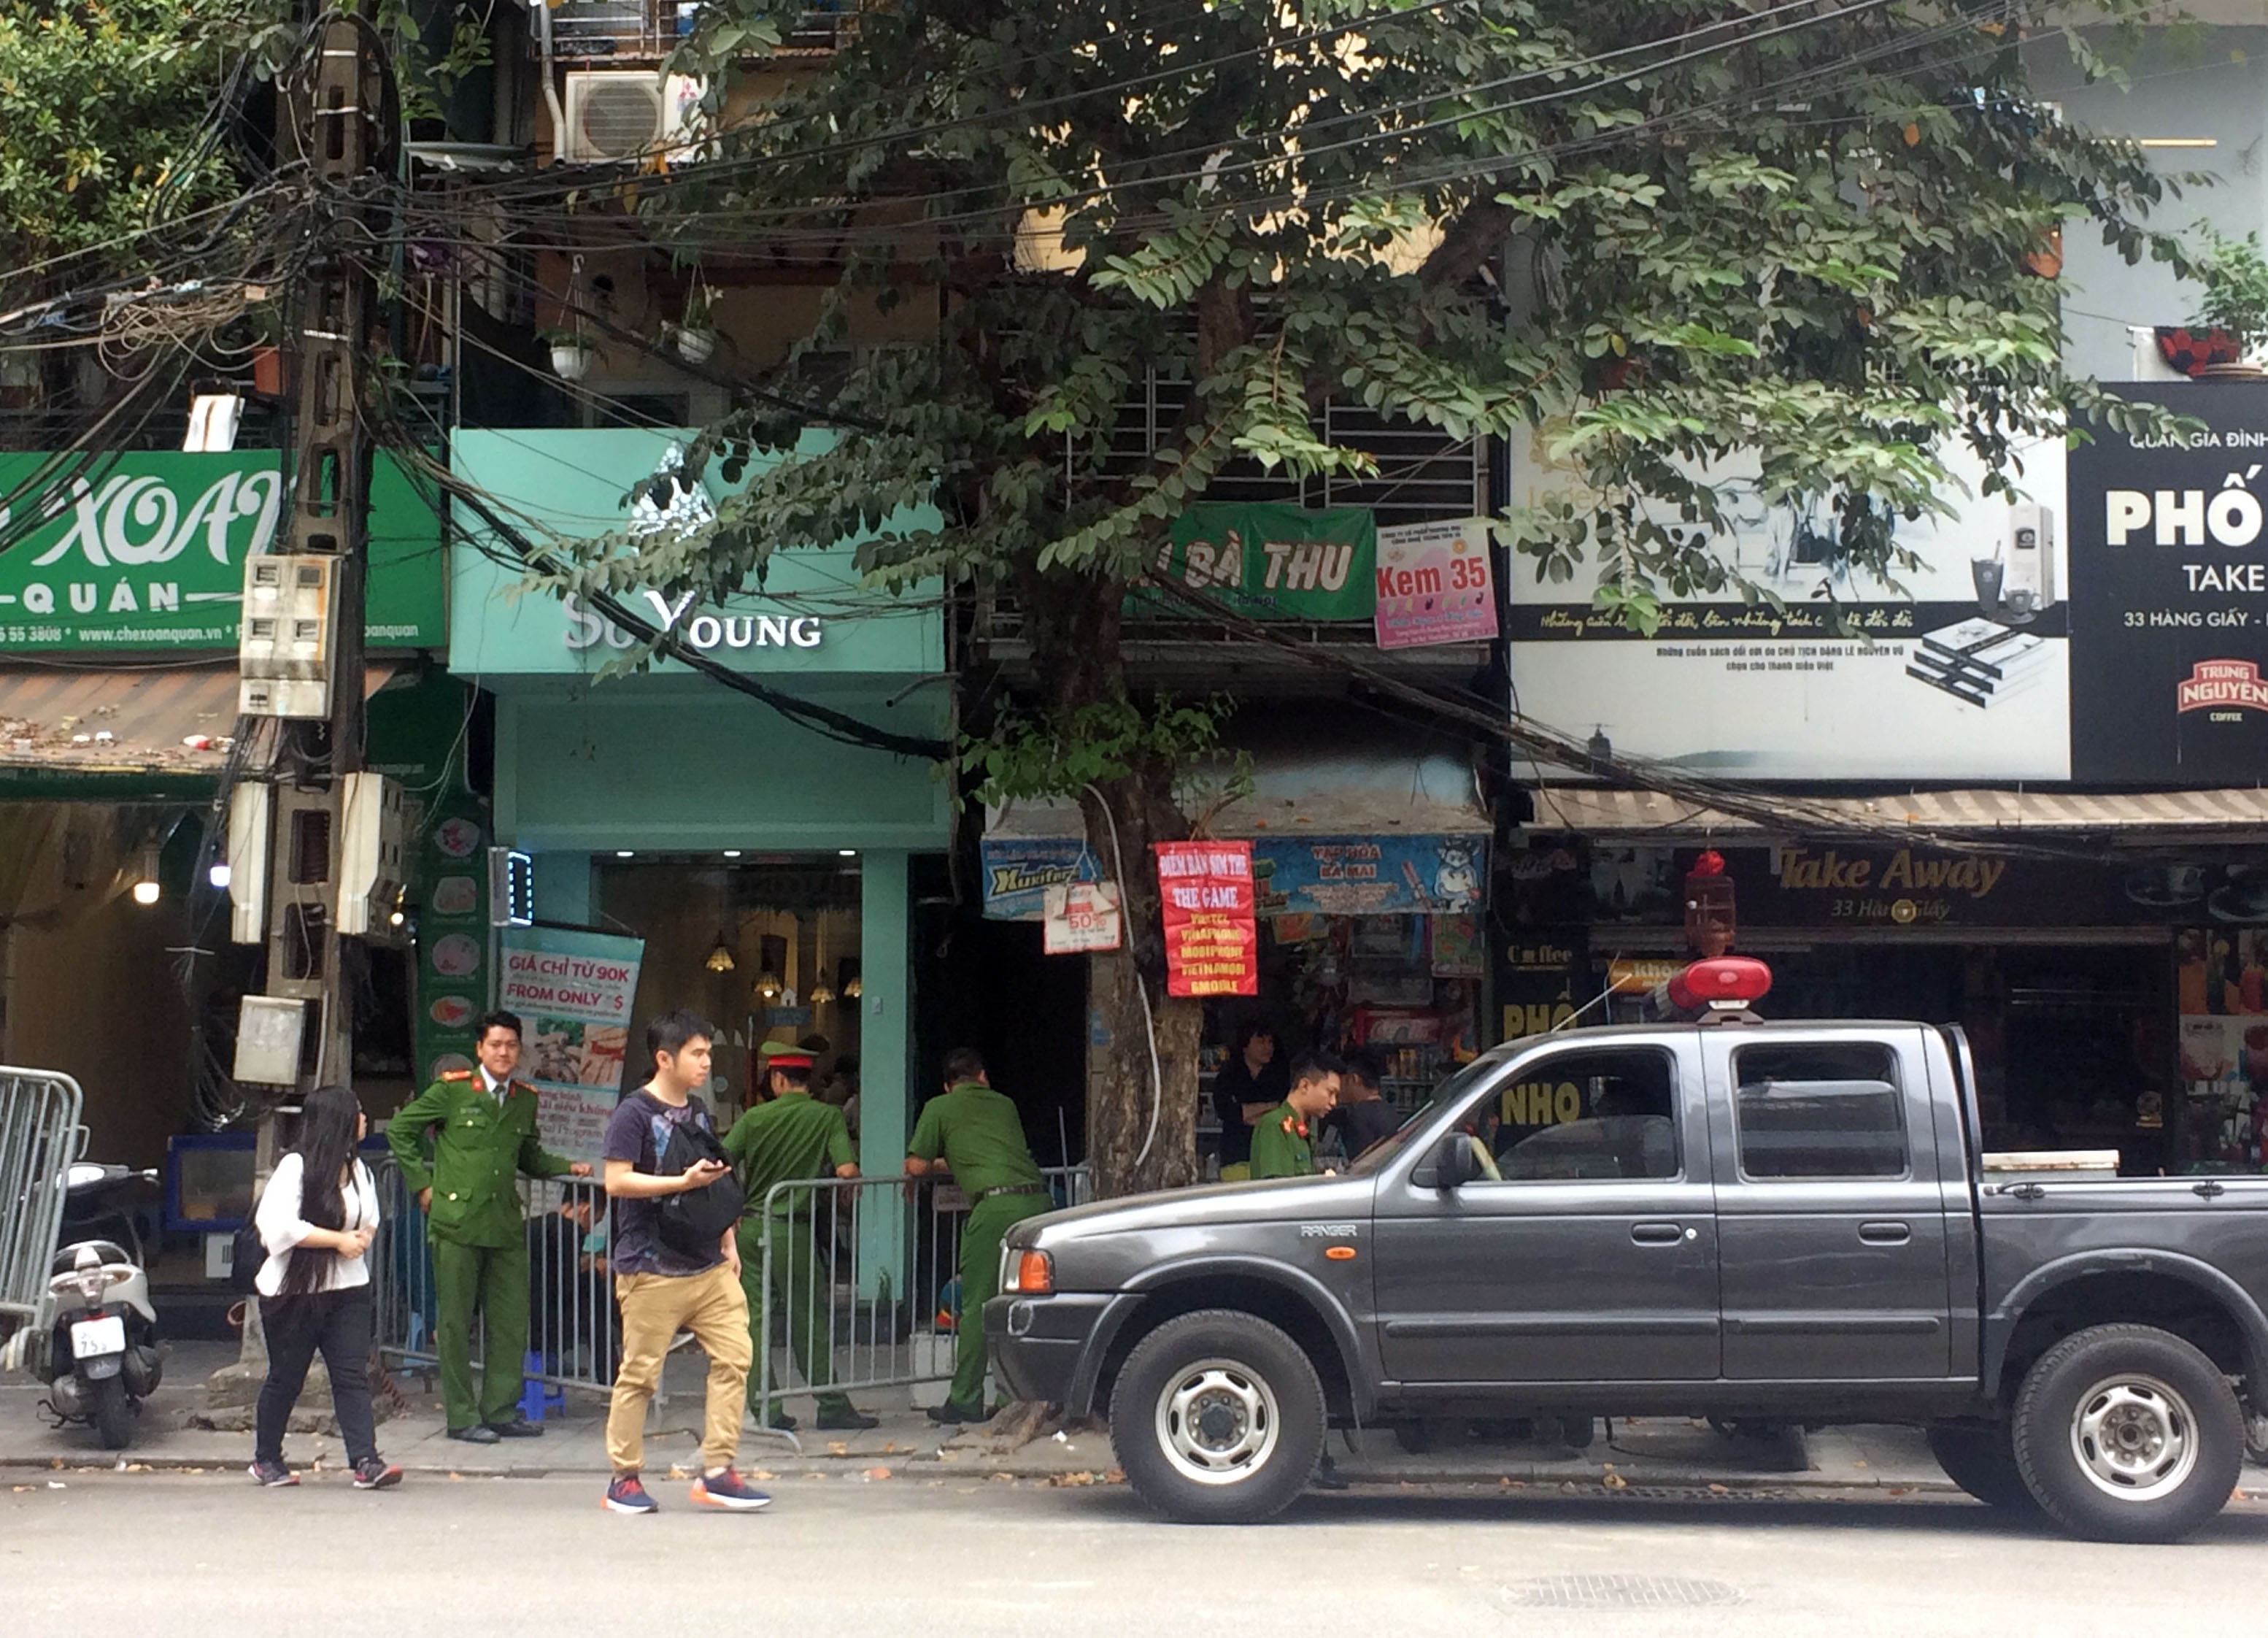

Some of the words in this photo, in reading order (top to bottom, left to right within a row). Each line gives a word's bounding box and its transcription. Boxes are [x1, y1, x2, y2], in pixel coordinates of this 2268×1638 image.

[2190, 432, 2221, 447] GIA
[2105, 464, 2263, 547] PHỐ
[1184, 529, 1241, 588] BÀ
[1263, 542, 1353, 591] THU
[1376, 566, 1442, 598] Kem
[1450, 557, 1486, 590] 35
[2182, 565, 2264, 592] TAKE
[23, 577, 179, 614] QUÁN
[2124, 612, 2145, 627] 33
[2150, 607, 2202, 627] HÀNG
[2207, 607, 2248, 627] GIẤY
[79, 625, 223, 644] www.chexoanquan.vn
[2200, 664, 2249, 680] TRUNG
[2183, 680, 2268, 704] NGUYÊN
[2210, 712, 2242, 722] COFFEE
[1780, 847, 1872, 889] Take
[1878, 849, 2005, 898] Away
[1202, 885, 1238, 909] GAME
[1832, 899, 1853, 917] 33
[509, 955, 537, 972] GIÁ
[540, 956, 569, 975] CHỈ
[571, 960, 595, 979] TỪ
[597, 965, 630, 983] 90K
[506, 983, 554, 1001] FROM
[558, 989, 601, 1007] ONLY
[614, 994, 624, 1010] $
[1300, 1224, 1357, 1237] RANGER
